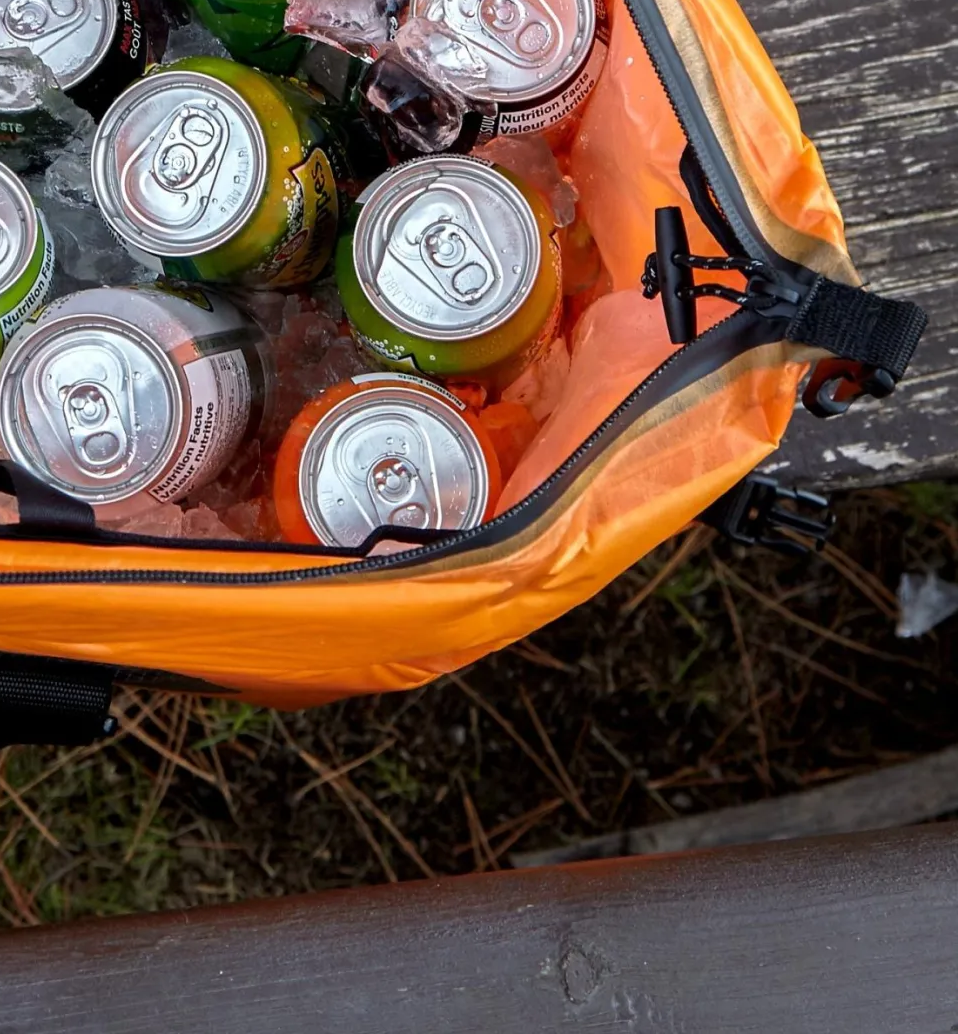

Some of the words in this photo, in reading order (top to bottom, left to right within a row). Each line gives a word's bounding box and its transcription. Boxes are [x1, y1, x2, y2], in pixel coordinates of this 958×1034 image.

[502, 100, 560, 124] Nutrition
[562, 73, 589, 102] Facts
[550, 79, 595, 123] nutritive
[2, 280, 45, 329] Nutrition
[42, 241, 53, 280] Facts
[153, 447, 194, 495] Nutrition
[189, 406, 203, 443] Facts
[195, 402, 214, 462] nutritive
